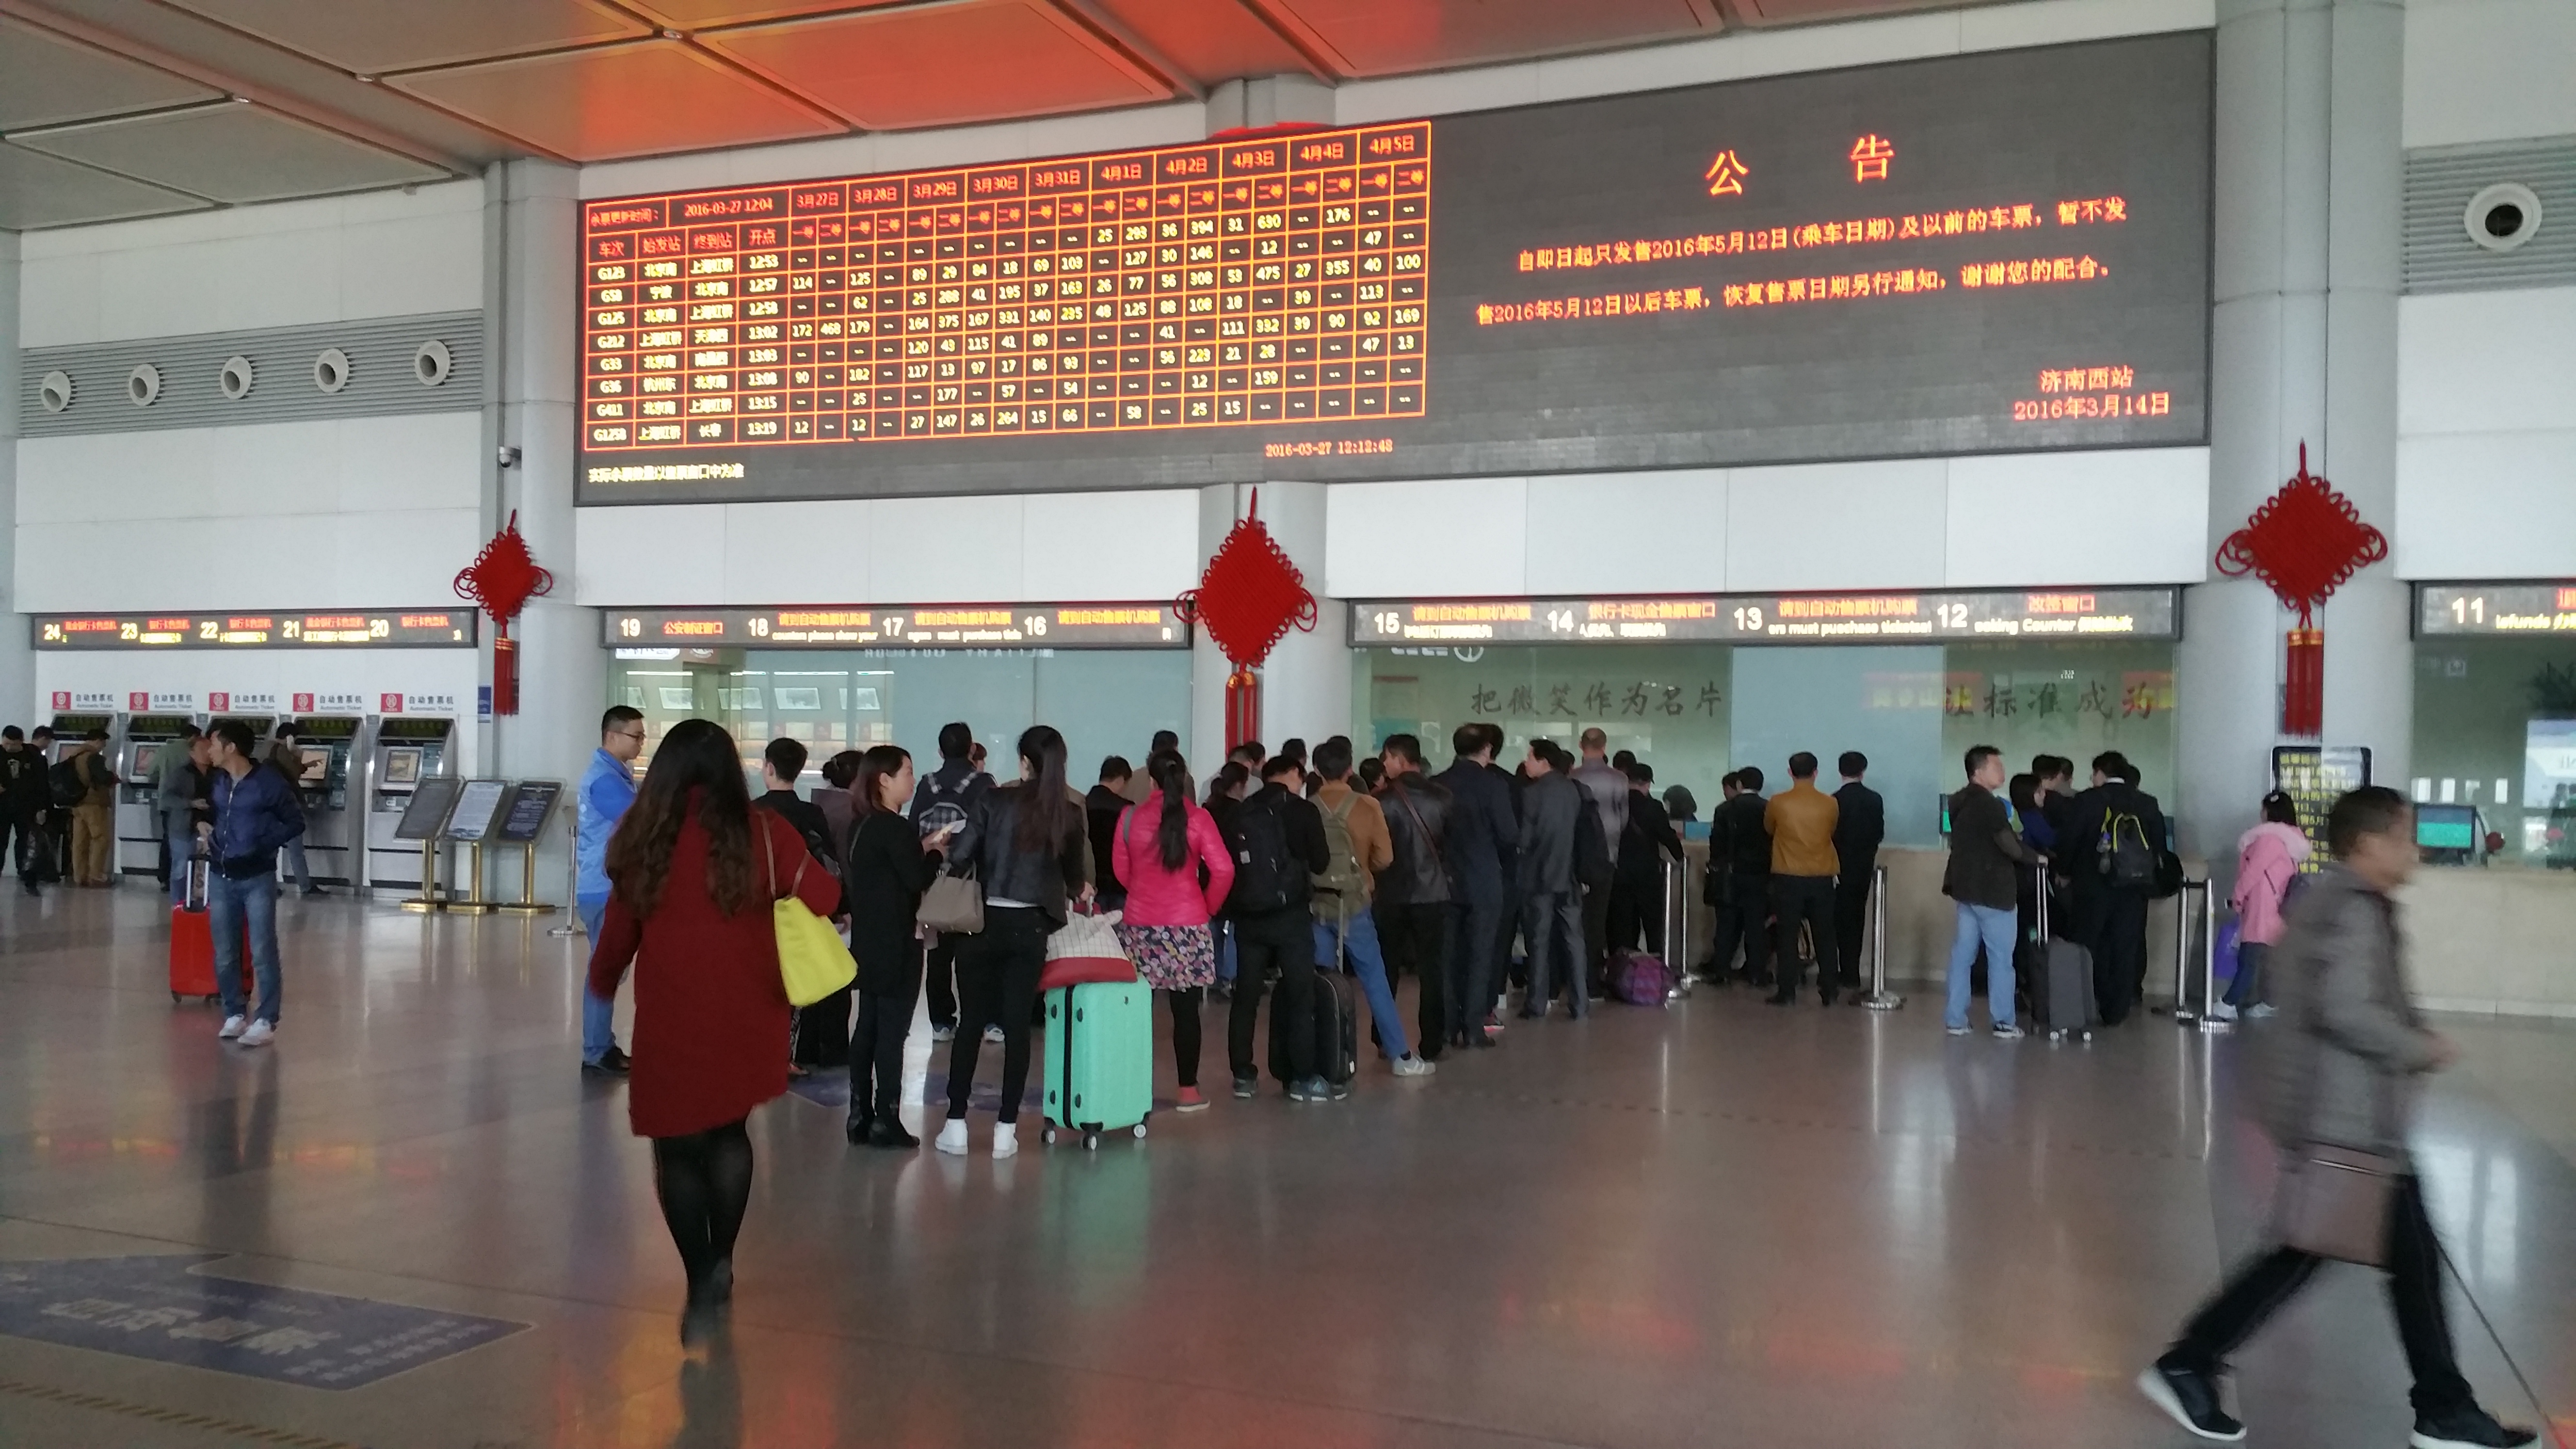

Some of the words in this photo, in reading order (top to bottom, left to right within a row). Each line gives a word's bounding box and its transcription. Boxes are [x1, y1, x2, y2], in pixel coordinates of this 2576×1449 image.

[797, 192, 838, 208] 3月27日
[854, 187, 897, 203] 3月28日
[914, 181, 956, 198] 3月29日
[973, 175, 1018, 193] 3月30日
[1035, 169, 1080, 187] 3月31日
[1101, 163, 1141, 181] 4月1日
[1166, 157, 1207, 175] 4月2日
[1232, 150, 1274, 168] 4月3日
[1300, 143, 1343, 161] 4月4日
[1369, 135, 1414, 154] 4月5日
[1705, 149, 1749, 195] 公
[1849, 134, 1895, 181] 告
[685, 200, 741, 217] 2016-03-27
[598, 267, 625, 280] G123
[1098, 229, 1112, 242] 25
[1162, 223, 1177, 237] 36
[1191, 220, 1213, 234] 394
[1228, 218, 1243, 231] 31
[1258, 214, 1281, 228] 630
[1327, 208, 1350, 223] 176
[599, 241, 624, 257] 车次
[749, 228, 775, 245] 开点
[793, 276, 812, 289] 114
[851, 273, 870, 285] 125
[943, 266, 957, 279] 29
[1003, 261, 1018, 274] 18
[1062, 256, 1082, 270] 103
[1126, 251, 1147, 265] 127
[1162, 249, 1177, 262] 30
[1191, 245, 1213, 260] 146
[1262, 241, 1277, 255] 12
[1365, 231, 1381, 244] 47
[598, 311, 625, 325] G125
[853, 296, 868, 308] 62
[912, 292, 926, 305] 25
[972, 288, 986, 300] 41
[1034, 283, 1048, 296] 37
[1097, 279, 1111, 292] 26
[1129, 276, 1143, 289] 77
[1162, 274, 1176, 288] 56
[1228, 269, 1242, 283] 53
[1256, 266, 1280, 280] 475
[1295, 263, 1311, 277] 27
[1326, 260, 1349, 275] 355
[1365, 258, 1381, 271] 40
[1397, 254, 1420, 269] 100
[598, 335, 625, 348] G212
[793, 324, 812, 337] 172
[850, 321, 869, 333] 179
[909, 317, 929, 330] 164
[939, 315, 959, 328] 375
[968, 313, 989, 326] 167
[999, 311, 1019, 324] 331
[1030, 309, 1051, 322] 140
[1125, 303, 1146, 316] 125
[1295, 290, 1311, 304] 39
[1360, 285, 1384, 299] 113
[600, 358, 622, 370] G33
[908, 341, 929, 354] 120
[941, 339, 955, 352] 43
[968, 337, 989, 351] 115
[1001, 336, 1016, 348] 41
[1160, 326, 1175, 338] 41
[1223, 321, 1245, 335] 111
[1256, 319, 1279, 333] 332
[1295, 316, 1310, 330] 39
[1329, 314, 1345, 328] 90
[1364, 311, 1380, 325] 92
[1396, 308, 1419, 323] 169
[796, 371, 809, 383] 90
[908, 365, 928, 378] 117
[941, 364, 954, 376] 13
[971, 362, 985, 374] 97
[1002, 360, 1016, 372] 17
[1160, 351, 1175, 364] 56
[1189, 348, 1210, 362] 223
[1226, 347, 1241, 360] 21
[1363, 338, 1380, 352] 47
[1399, 336, 1414, 350] 13
[2041, 365, 2134, 393] 济南西站
[597, 404, 623, 416] G411
[853, 393, 866, 405] 25
[937, 388, 957, 401] 177
[1002, 385, 1015, 397] 57
[1064, 382, 1078, 395] 54
[1192, 374, 1208, 388] 12
[1255, 371, 1278, 385] 159
[795, 421, 808, 433] 12
[853, 419, 866, 431] 12
[911, 416, 924, 428] 27
[937, 415, 957, 427] 147
[970, 413, 984, 426] 26
[1032, 410, 1046, 423] 15
[1191, 402, 1207, 416] 25
[1225, 401, 1240, 415] 15
[2014, 391, 2170, 421] 2016年3月14日
[1265, 442, 1332, 457] 2016-03-27
[1374, 612, 1400, 633] 15
[1547, 610, 1574, 632] 14
[1734, 607, 1762, 630] 13
[1937, 603, 1968, 628] 12
[2452, 597, 2483, 624] 11
[45, 624, 61, 640] 24
[121, 623, 138, 639] 23
[200, 622, 218, 639] 22
[283, 621, 300, 638] 21
[370, 619, 389, 637] 20
[621, 618, 640, 637] 19
[749, 618, 768, 637] 18
[883, 617, 904, 636] 17
[1024, 616, 1046, 635] 16
[320, 695, 362, 704] 自动售票机
[409, 696, 454, 705] 自动售票机
[1470, 680, 1723, 717] 把微笑作为名片
